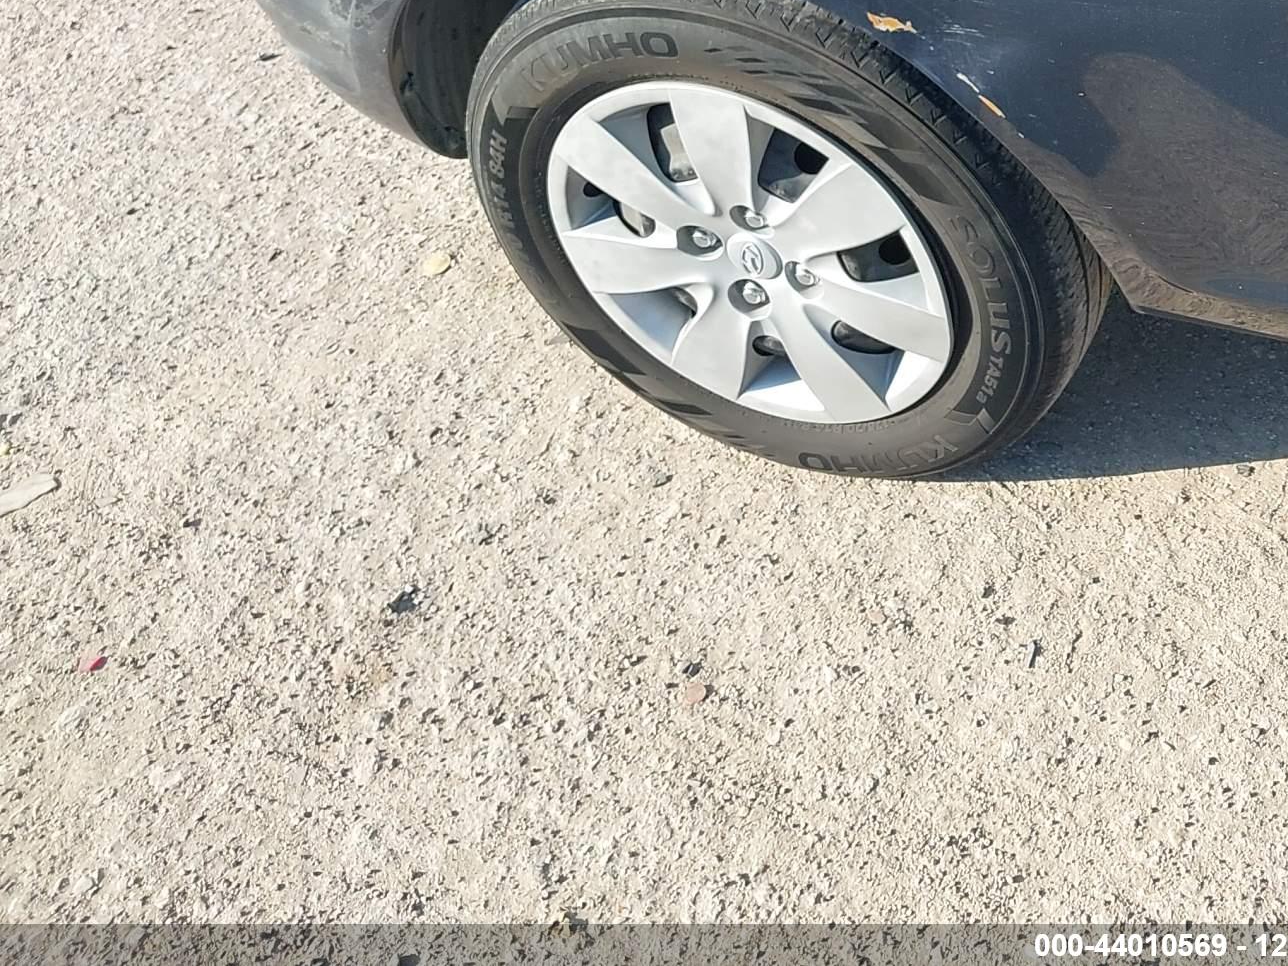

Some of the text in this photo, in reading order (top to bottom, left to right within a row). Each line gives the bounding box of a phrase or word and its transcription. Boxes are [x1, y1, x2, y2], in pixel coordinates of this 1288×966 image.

[520, 31, 679, 92] KUMHO
[488, 129, 508, 180] 84H
[950, 214, 1012, 356] SOLUS
[798, 434, 959, 474] KUMHO
